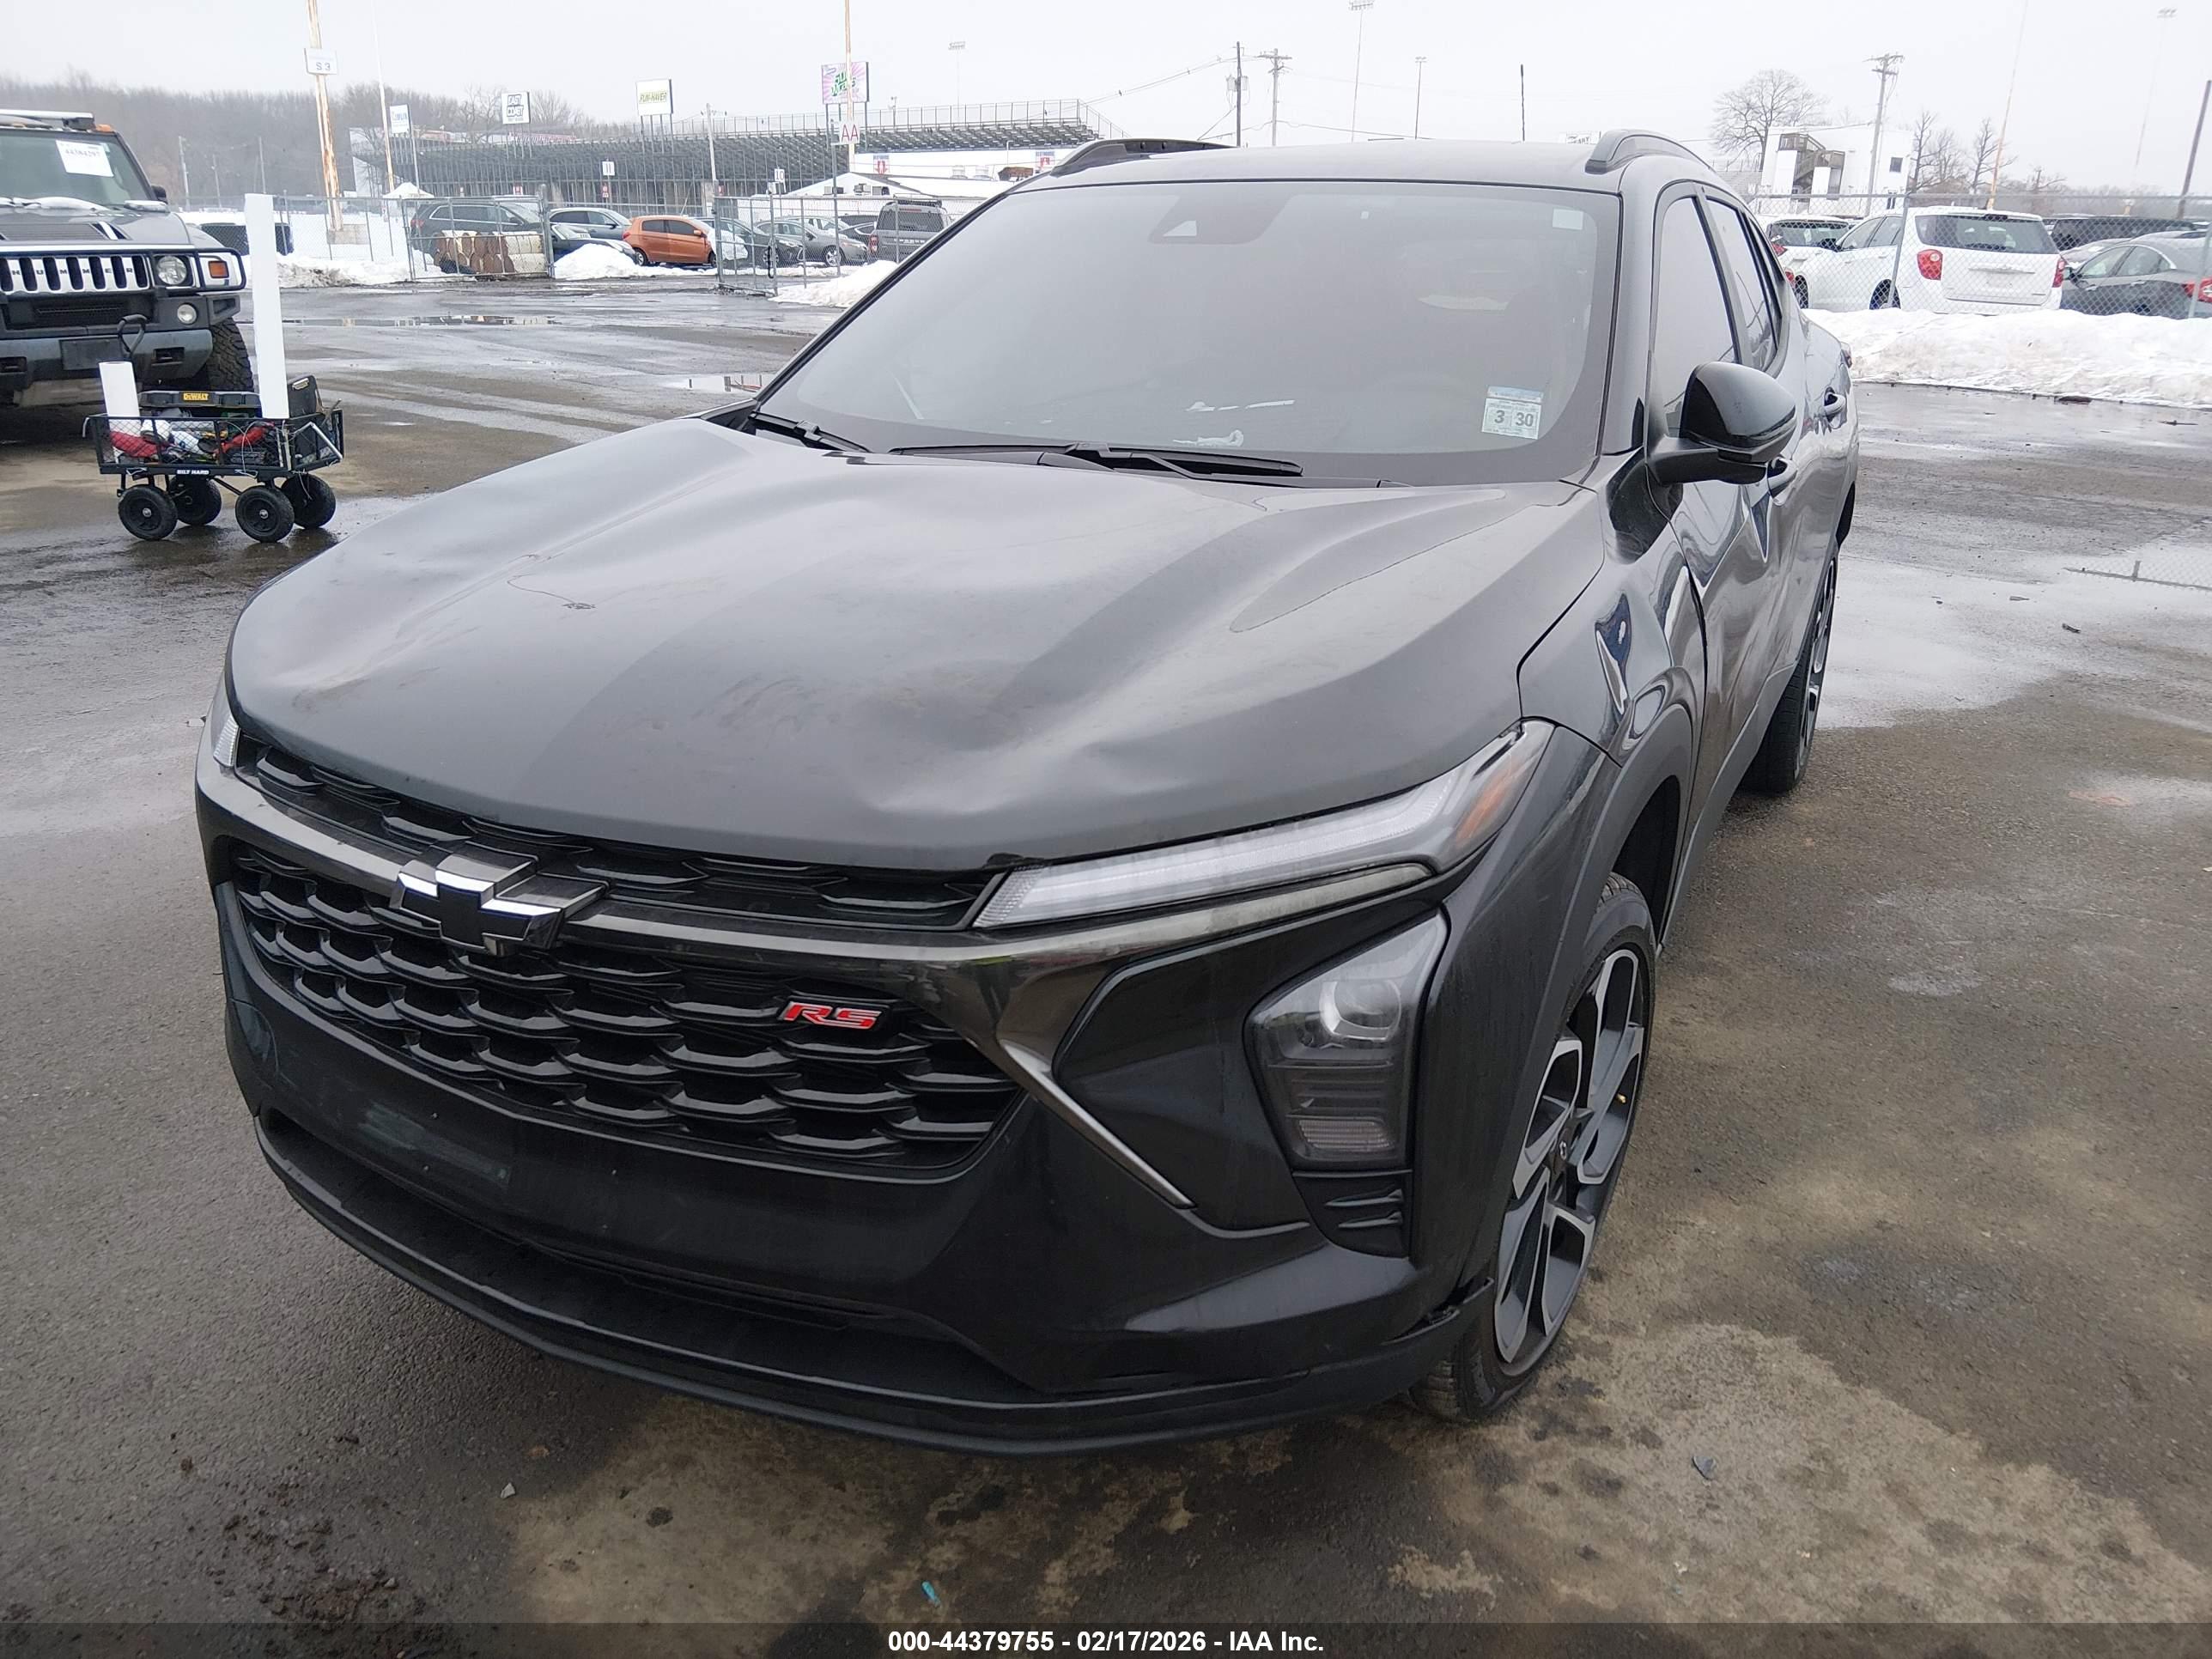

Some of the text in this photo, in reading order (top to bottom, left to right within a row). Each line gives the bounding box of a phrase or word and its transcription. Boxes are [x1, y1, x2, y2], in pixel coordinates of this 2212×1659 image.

[842, 124, 859, 142] AA
[775, 170, 785, 180] 10
[11, 267, 133, 276] HUMMER
[1494, 410, 1534, 427] 3 30
[777, 1001, 883, 1030] RS
